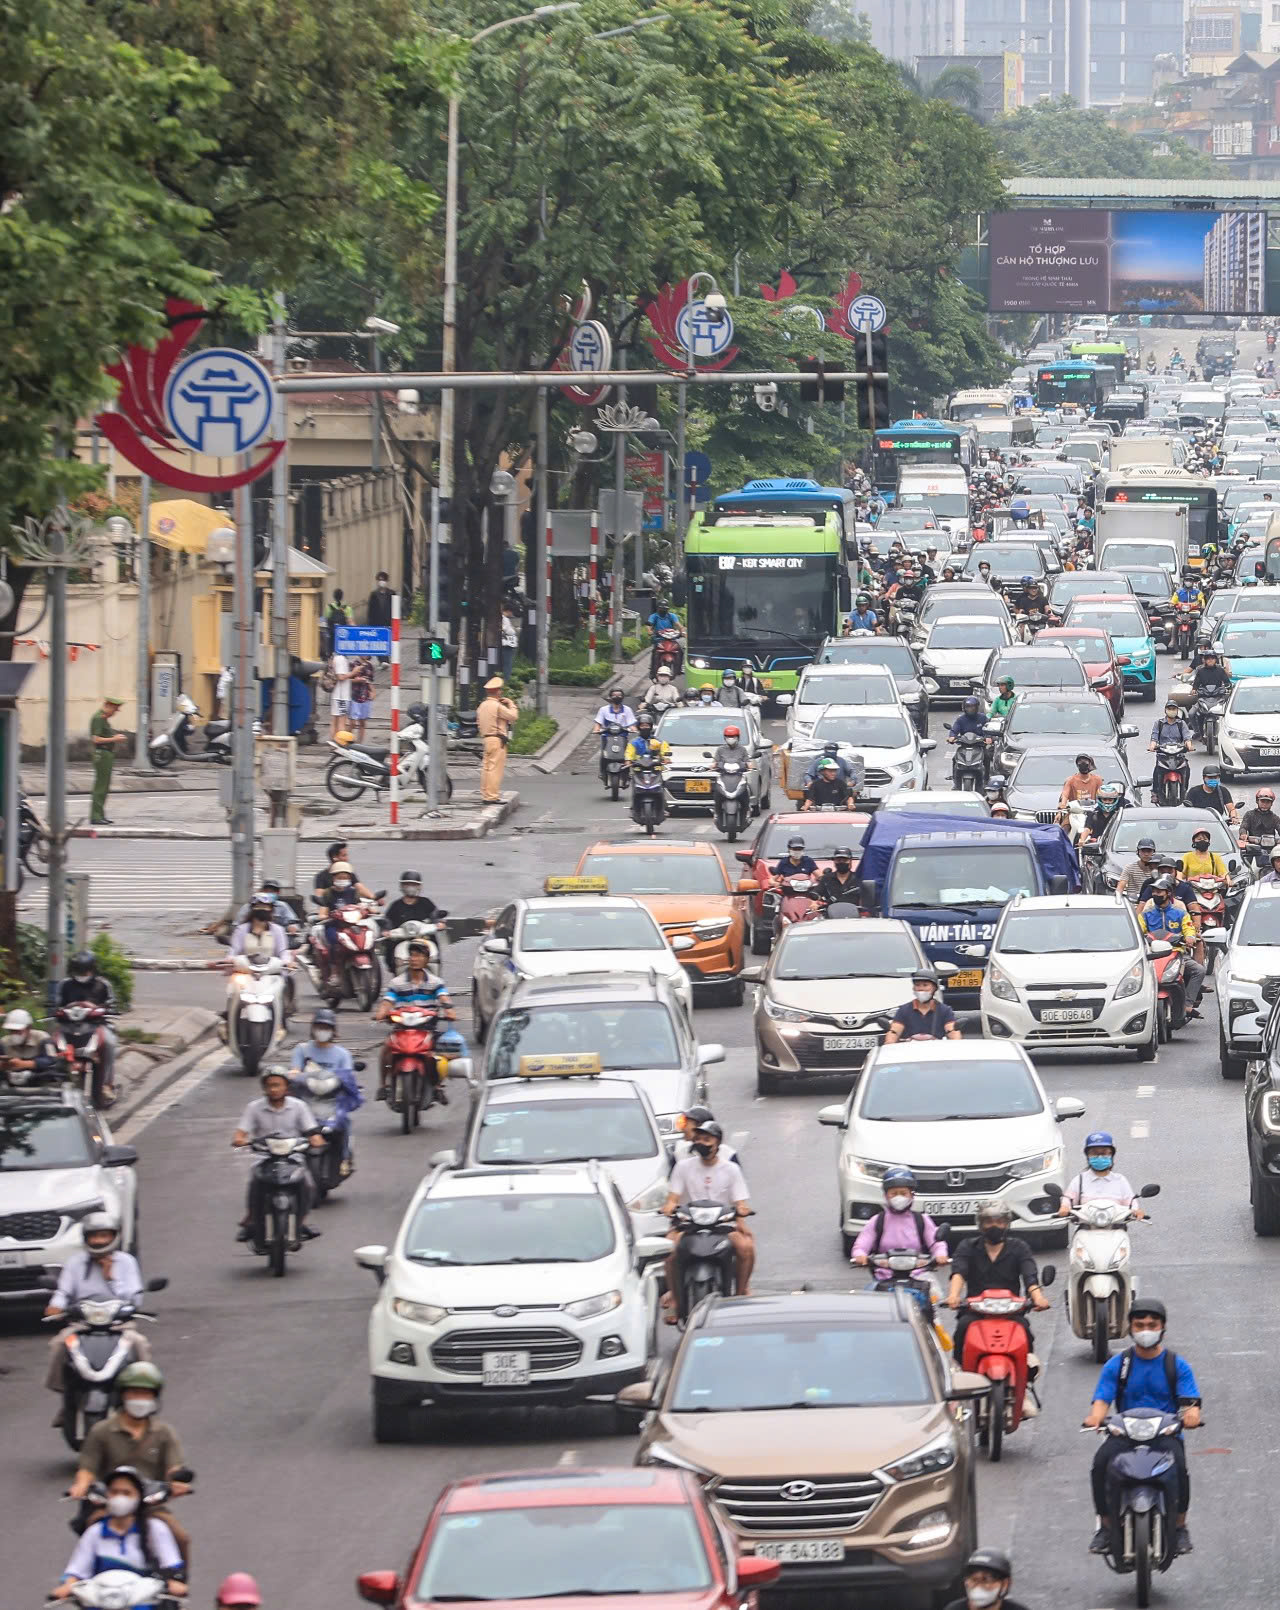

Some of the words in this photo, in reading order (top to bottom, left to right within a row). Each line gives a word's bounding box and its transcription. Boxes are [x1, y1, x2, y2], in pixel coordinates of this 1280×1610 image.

[759, 558, 786, 568] SMART
[1042, 1011, 1091, 1021] 30E-096.48
[824, 1038, 876, 1049] 30G-234.86
[926, 1201, 988, 1214] 30F-937.3
